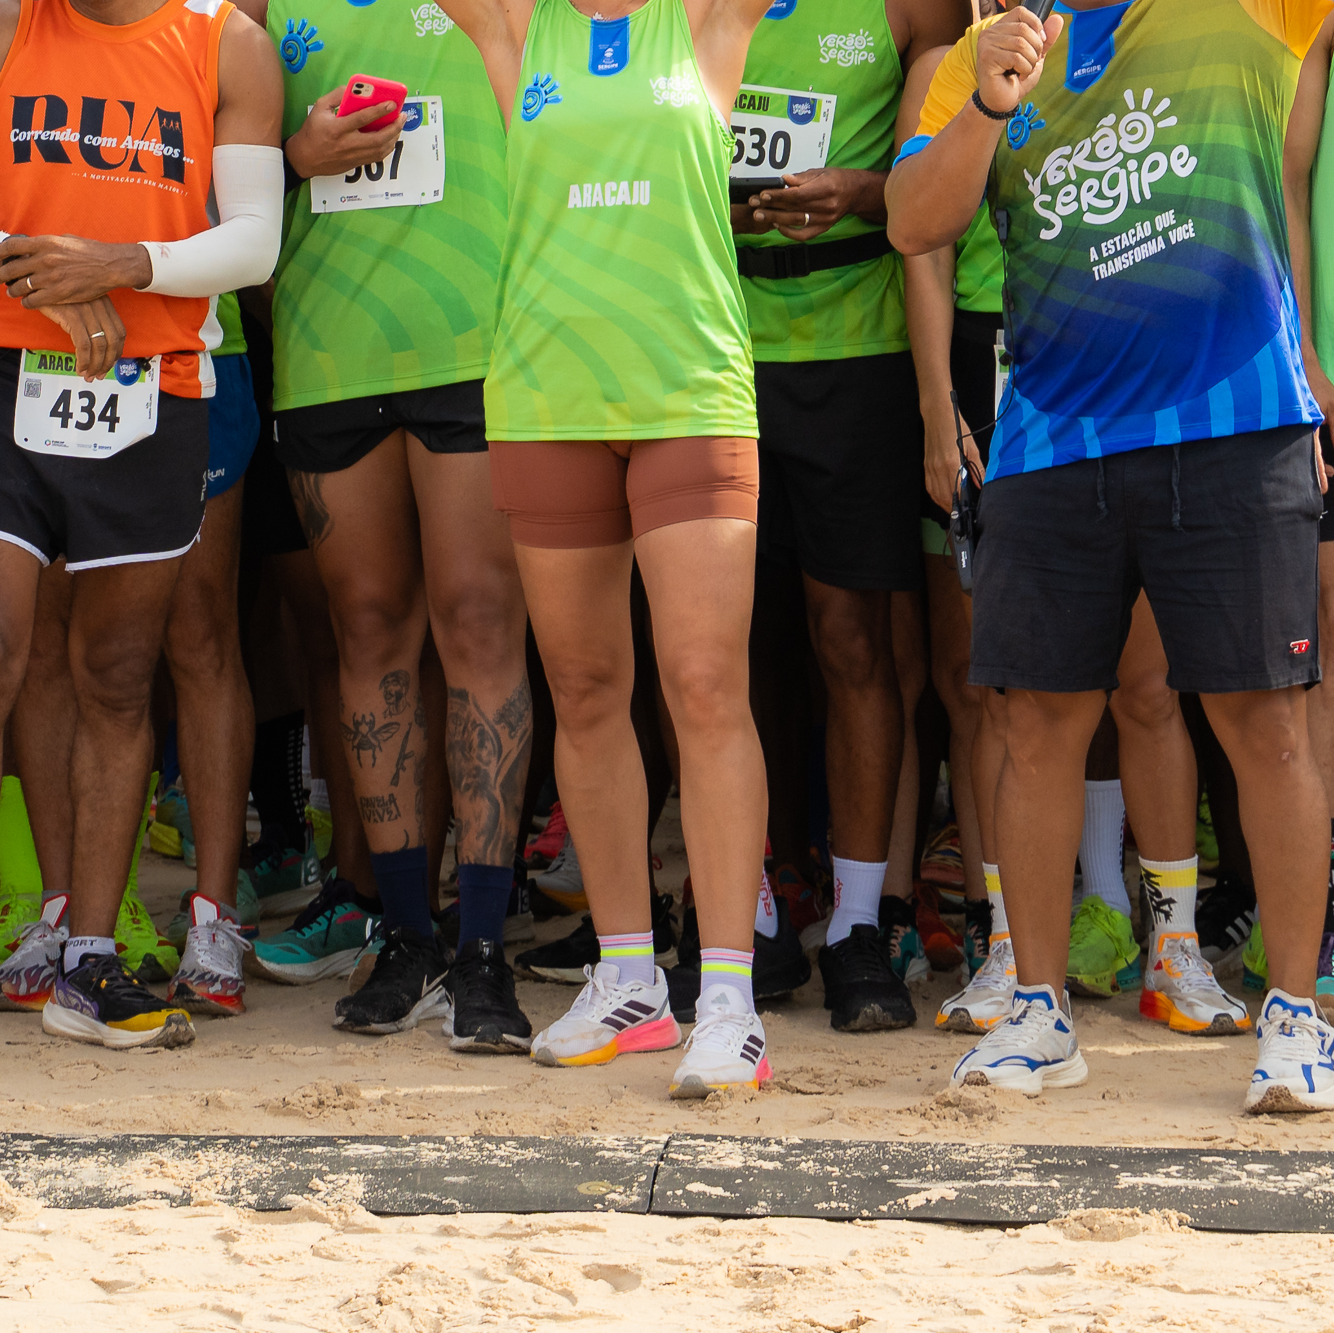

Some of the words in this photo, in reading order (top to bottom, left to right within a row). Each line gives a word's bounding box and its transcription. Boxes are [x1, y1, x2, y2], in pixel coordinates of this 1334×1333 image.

[819, 47, 876, 67] Sergipe
[1073, 64, 1102, 79] SERGIPE
[734, 94, 771, 112] CAJU
[10, 127, 80, 144] Correndo
[84, 132, 118, 148] com
[121, 133, 181, 159] Amigos
[11, 94, 187, 185] RUA
[730, 125, 791, 170] 530
[90, 173, 135, 184] MOTIVAÇÃO
[567, 180, 650, 208] ARACAJU
[1033, 145, 1198, 240] Sergipe
[1089, 246, 1099, 263] A
[1100, 220, 1152, 258] ESTAÇÃO
[1154, 209, 1177, 232] QUE
[1092, 235, 1166, 281] TRANSFORMA
[1168, 218, 1196, 245] VOCÊ
[37, 354, 77, 372] ARAC
[49, 388, 121, 433] 434
